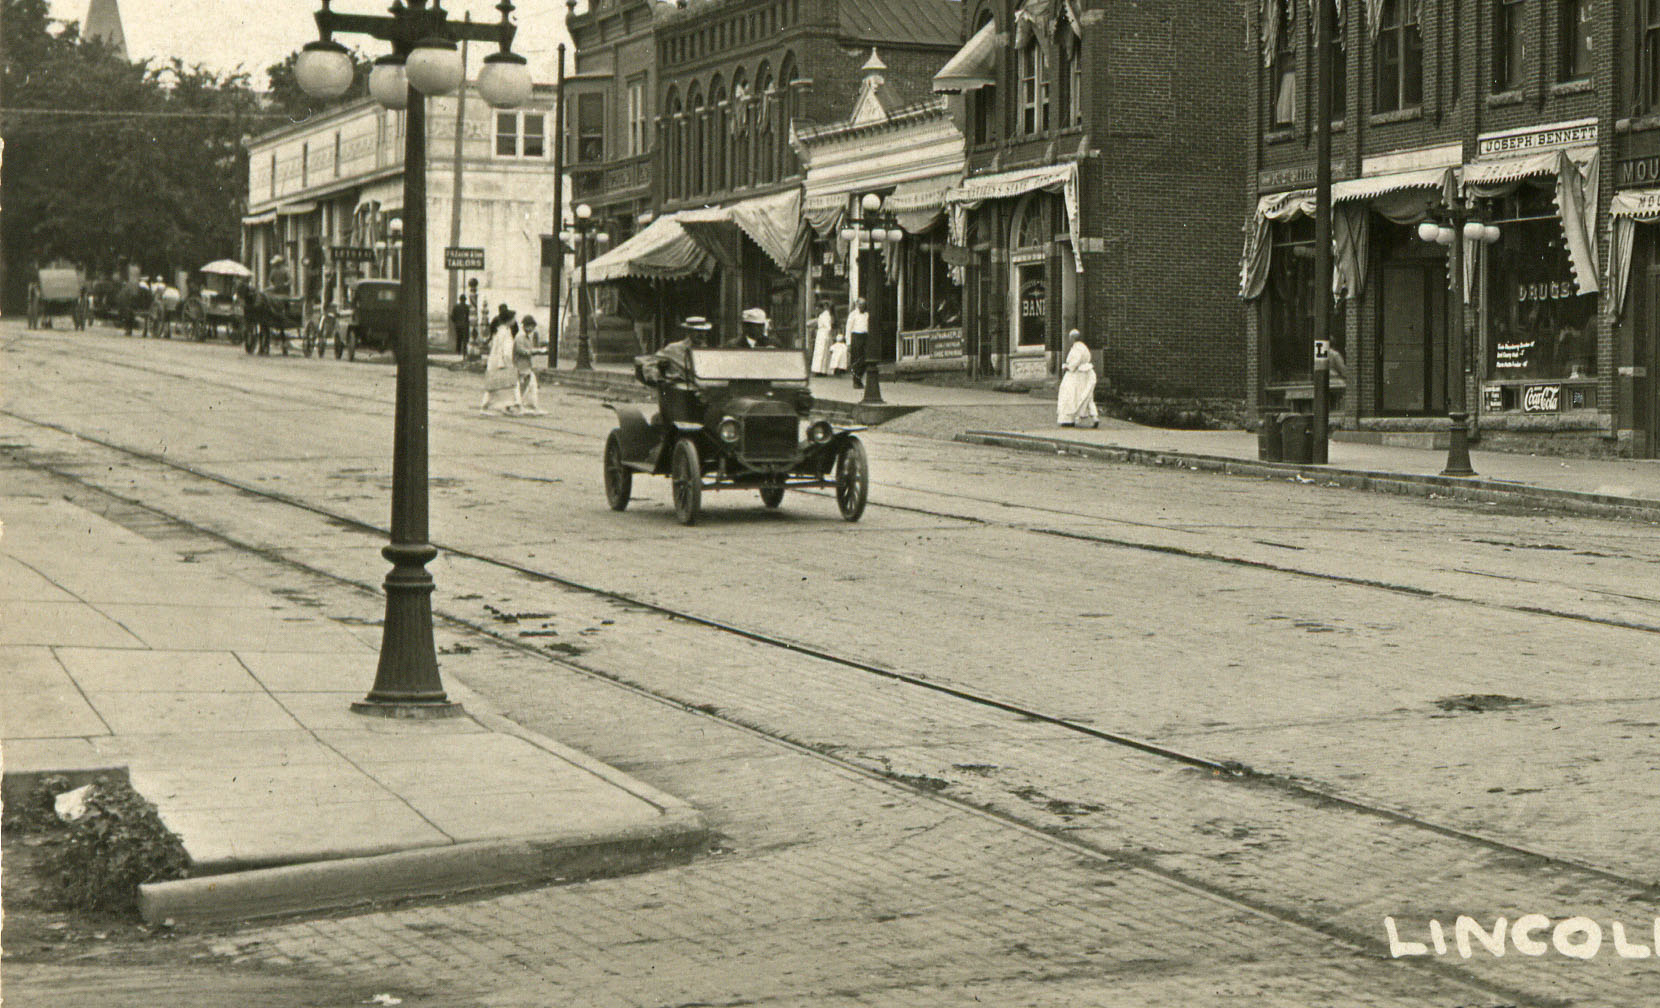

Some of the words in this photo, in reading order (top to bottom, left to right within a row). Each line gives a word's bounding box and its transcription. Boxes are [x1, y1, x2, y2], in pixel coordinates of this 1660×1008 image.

[1486, 135, 1532, 152] JOSEPH
[1538, 127, 1596, 145] BENNETT
[1519, 281, 1571, 301] DRUGS
[1316, 343, 1328, 358] L
